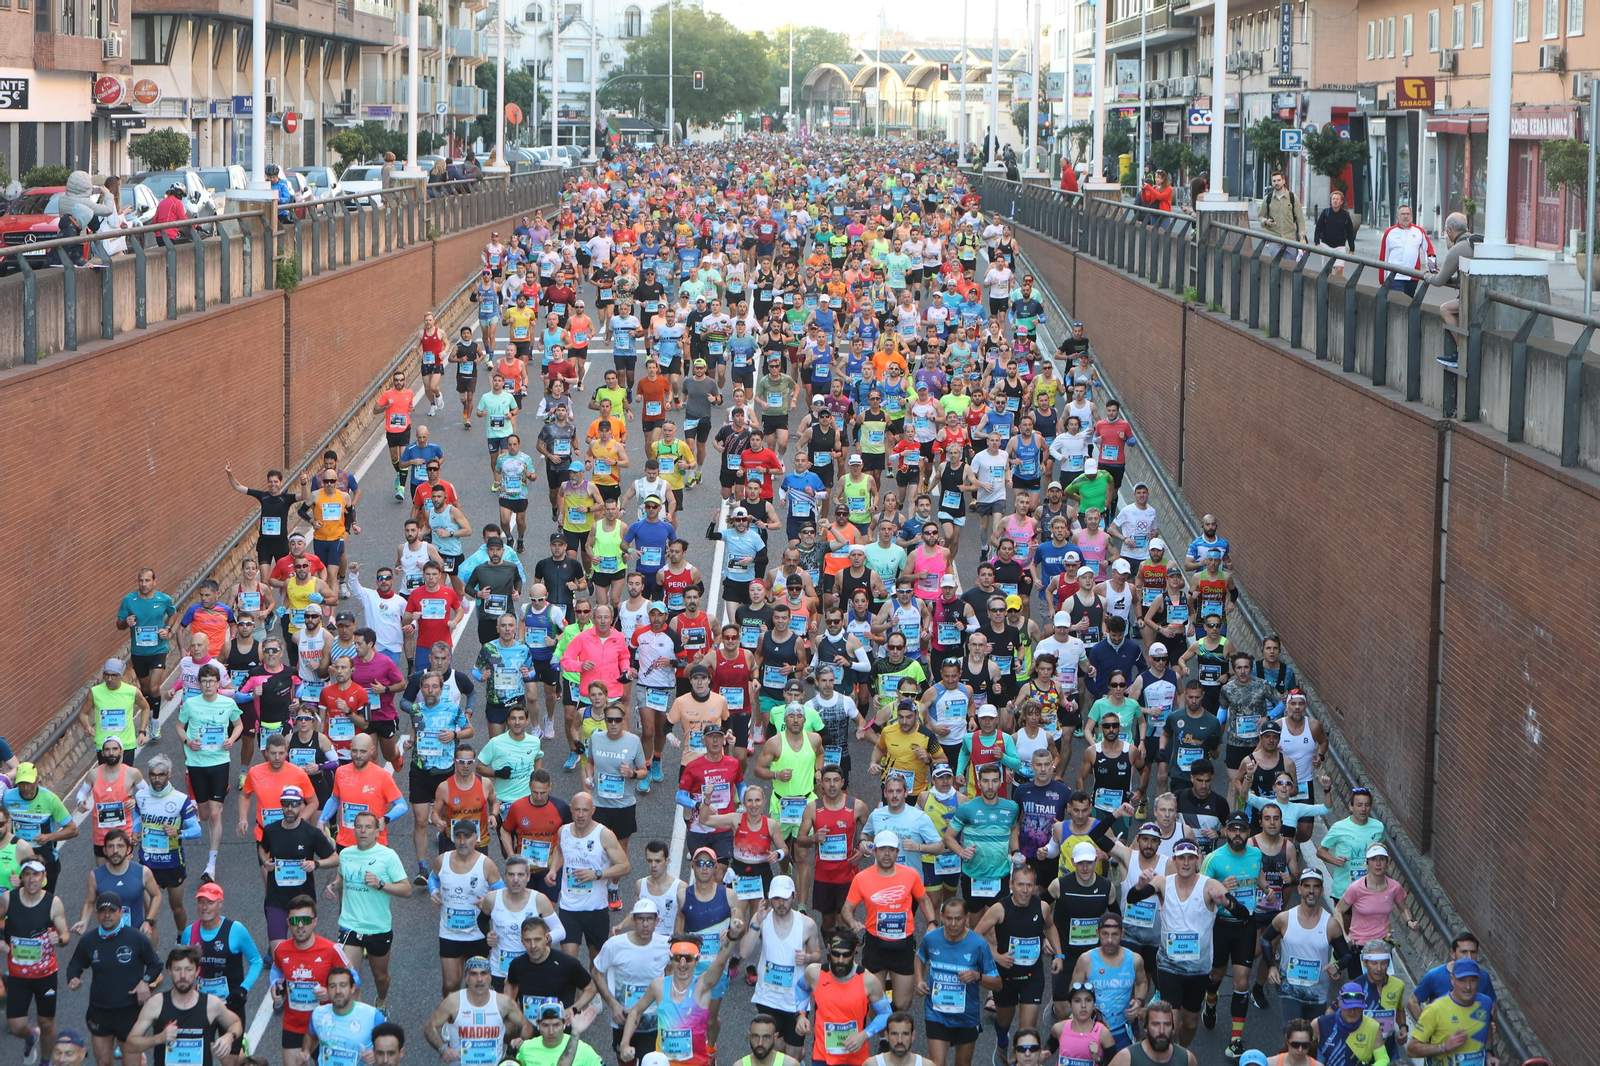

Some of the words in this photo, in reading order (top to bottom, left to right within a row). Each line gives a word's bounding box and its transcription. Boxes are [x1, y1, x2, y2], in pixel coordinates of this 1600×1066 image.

[97, 83, 120, 100] Cruzcampo
[1511, 118, 1528, 135] DONER
[1530, 118, 1547, 135] KEBAB
[1285, 132, 1298, 149] P
[596, 750, 625, 759] MATTIAS
[1035, 804, 1056, 814] TRAIL
[566, 857, 590, 865] SAMBA
[934, 972, 958, 983] RAMÓ
[458, 1026, 500, 1039] MADRID
